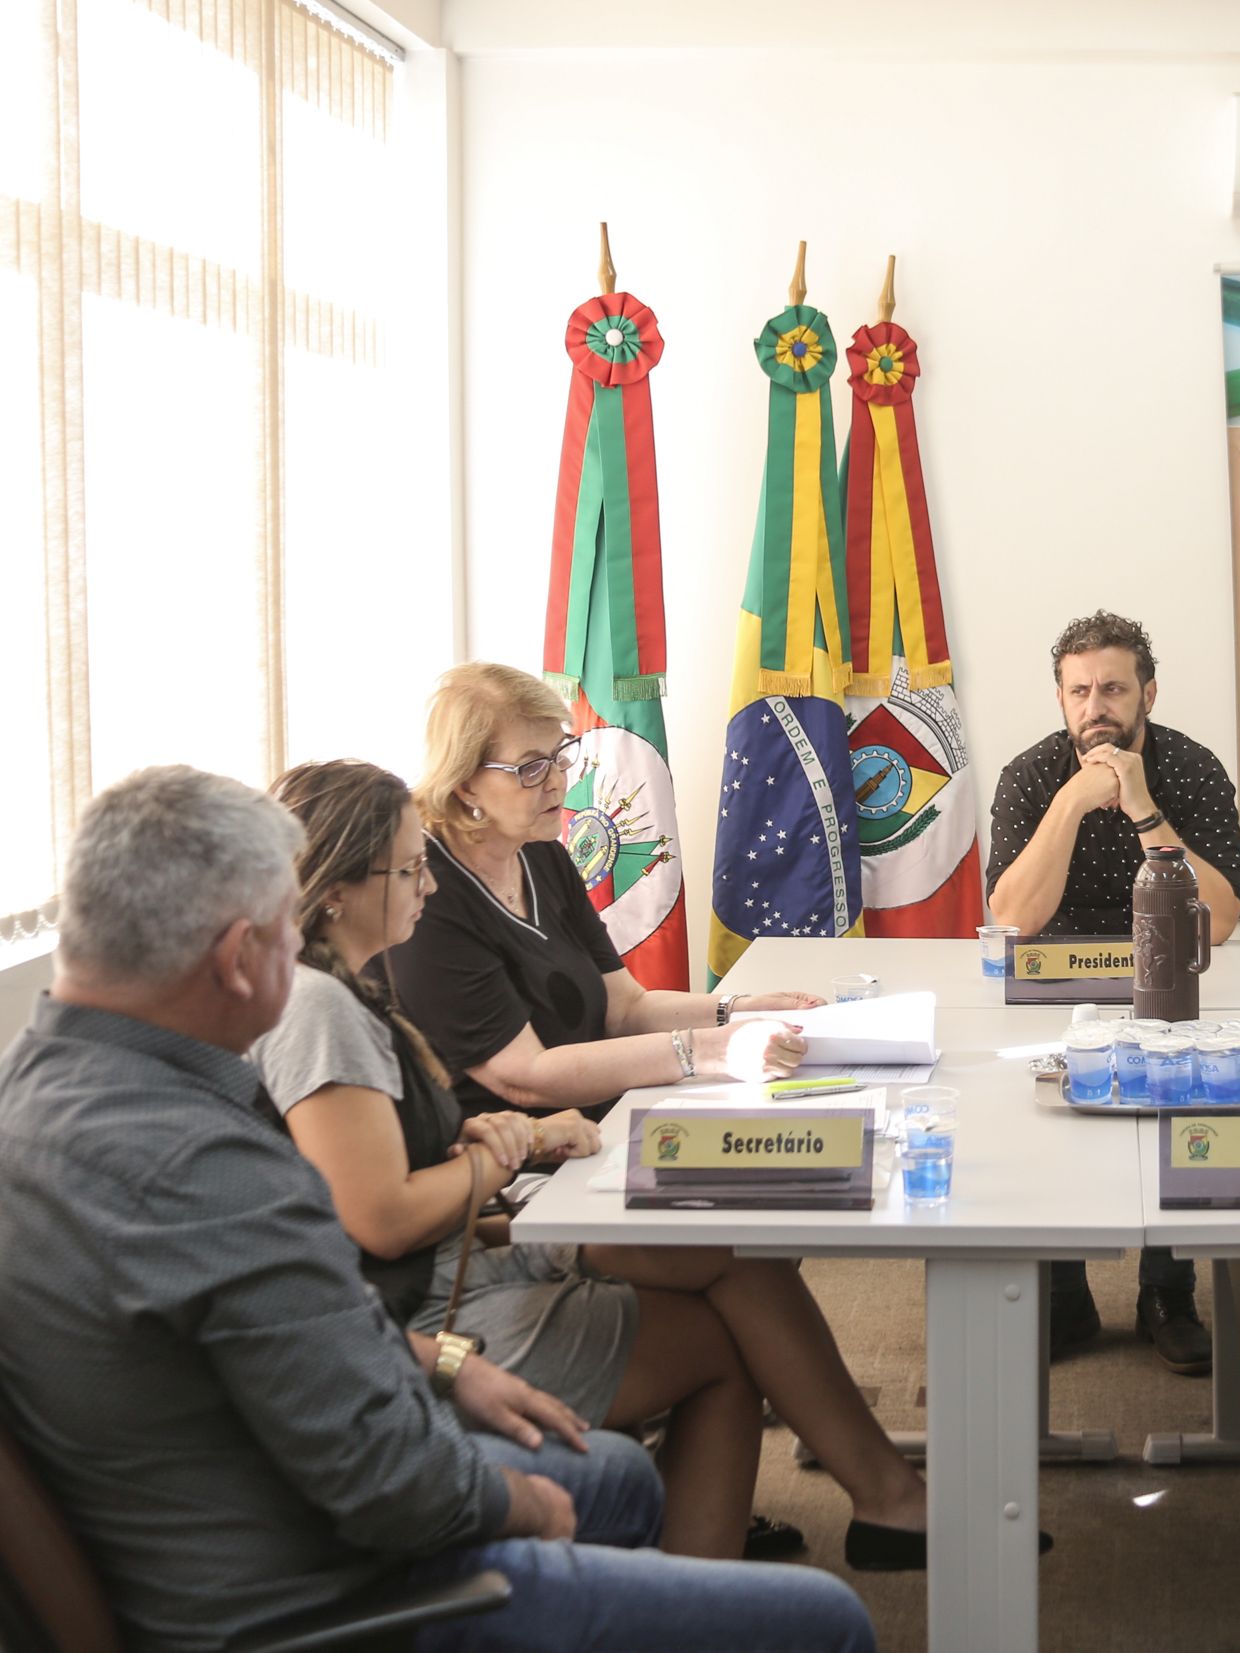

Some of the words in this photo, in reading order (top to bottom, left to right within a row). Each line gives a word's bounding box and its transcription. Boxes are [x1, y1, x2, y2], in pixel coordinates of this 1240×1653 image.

[773, 700, 816, 766] ORDEM
[812, 778, 827, 791] E
[821, 803, 847, 928] PROGRESSO
[1068, 952, 1134, 969] President
[722, 1130, 824, 1154] Secretário
